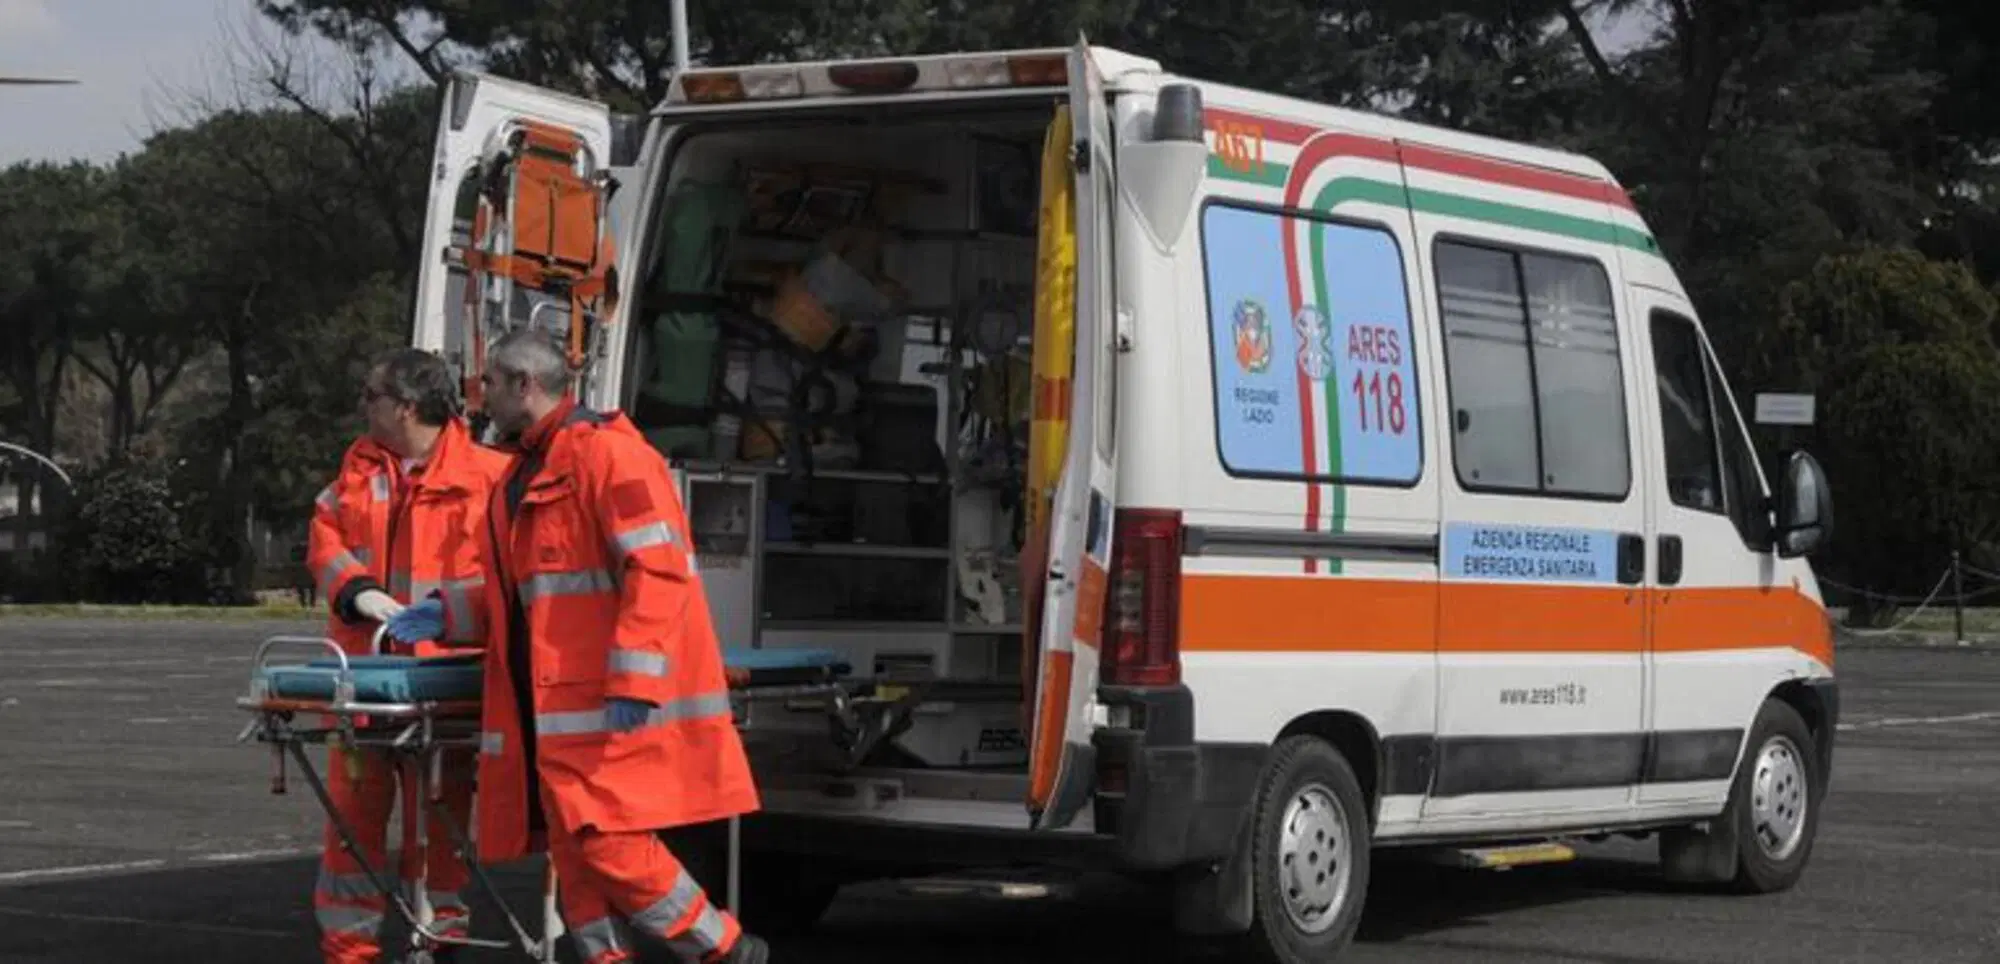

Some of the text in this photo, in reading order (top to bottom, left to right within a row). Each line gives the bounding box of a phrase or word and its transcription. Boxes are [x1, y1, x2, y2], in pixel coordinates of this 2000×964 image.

[1348, 324, 1402, 366] ARES
[1353, 369, 1405, 435] 118
[1472, 528, 1592, 554] AZIENDA REGIONALE
[1463, 554, 1597, 578] EMERGENZA SANITARIA
[1499, 682, 1587, 705] www.ares118.it
